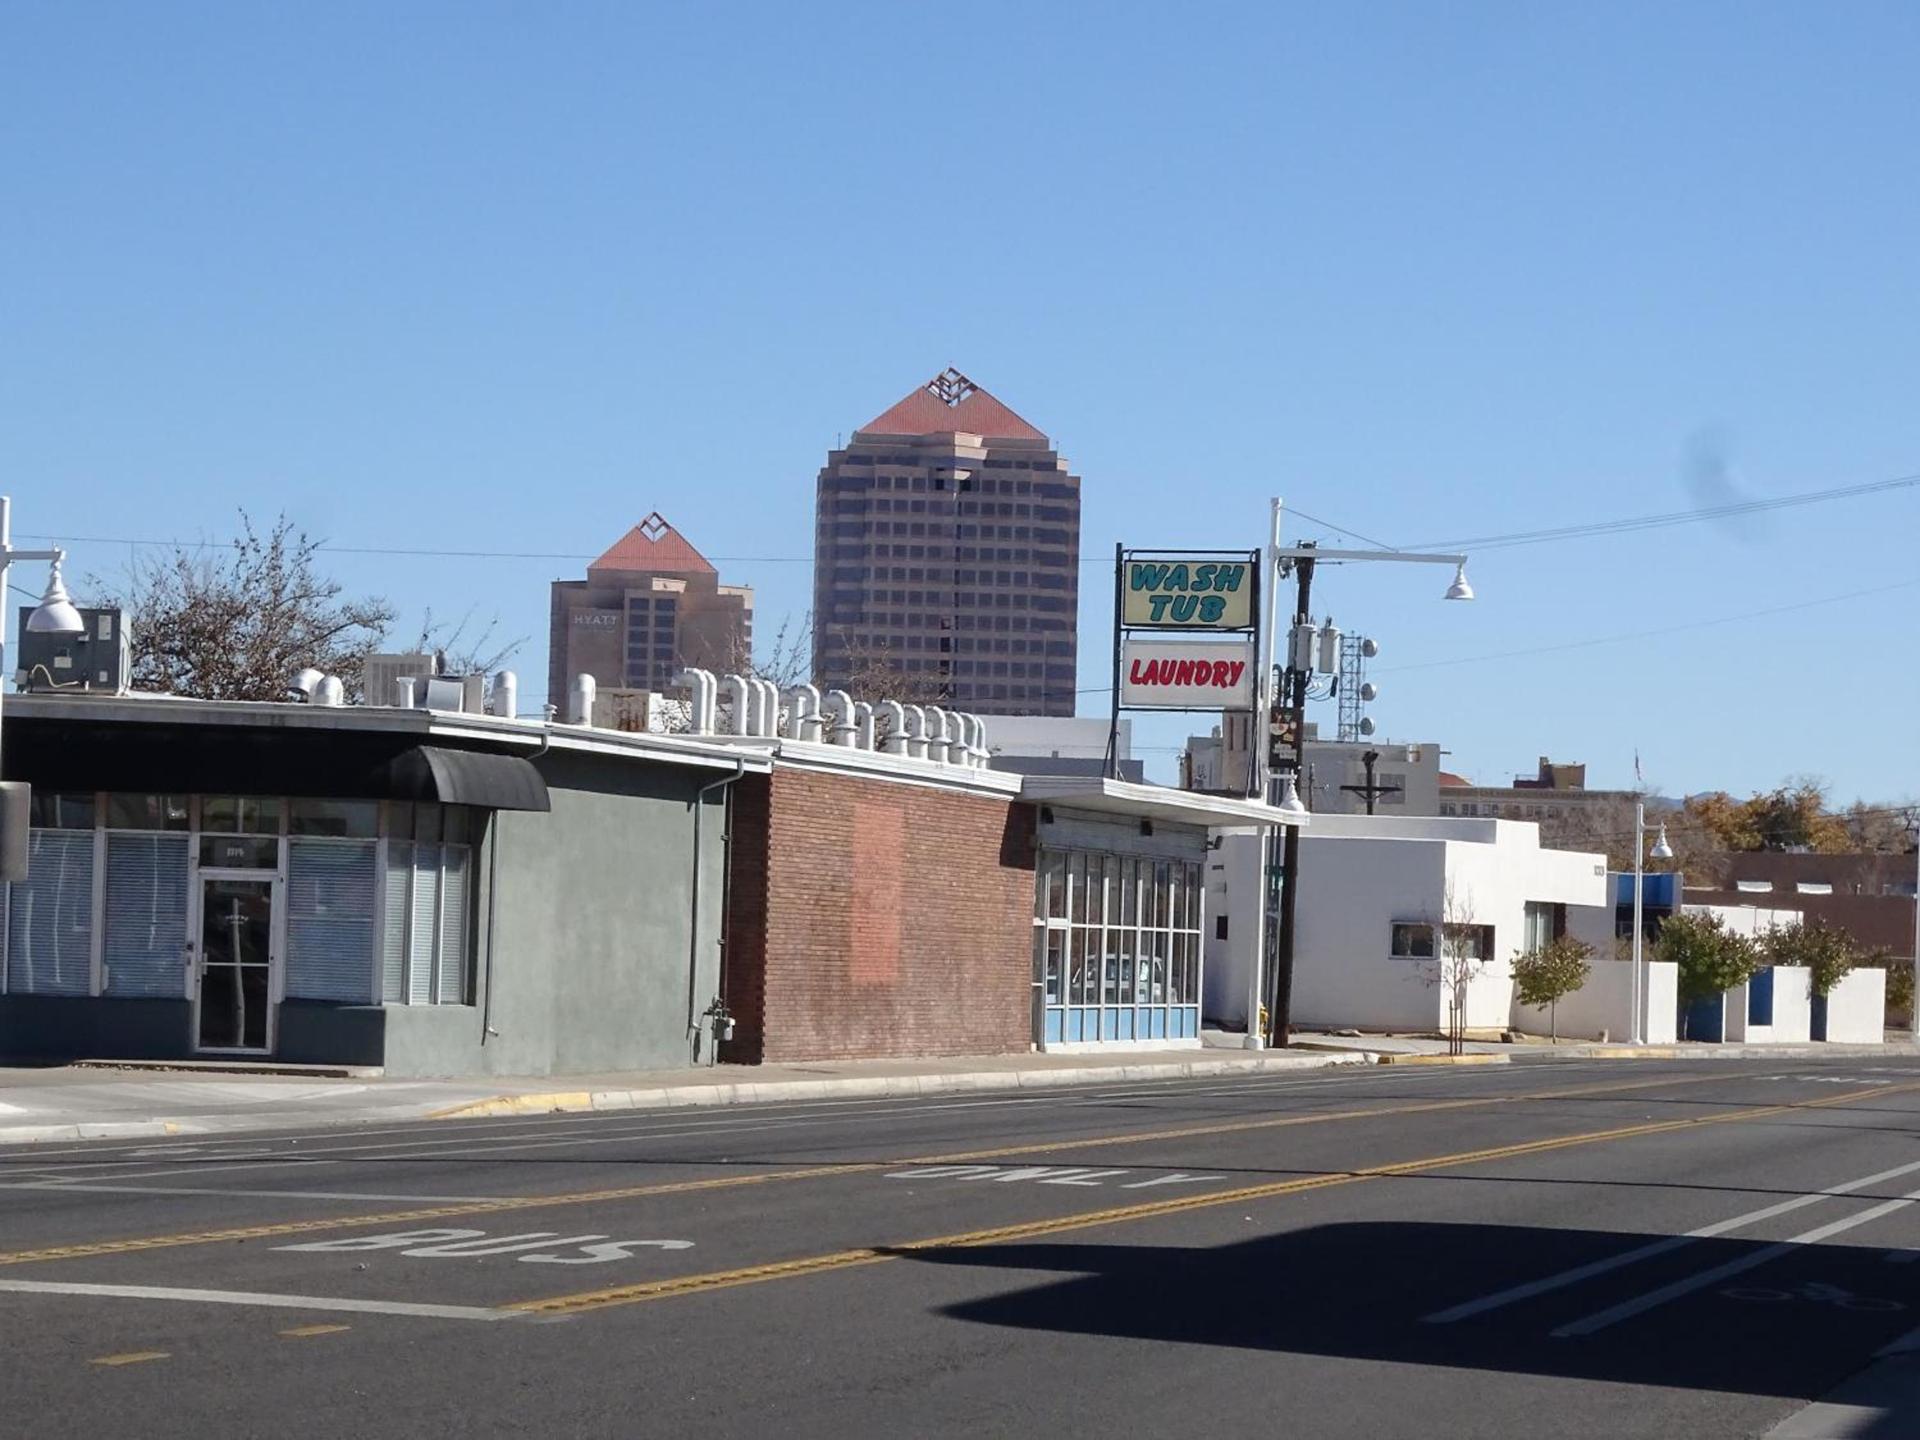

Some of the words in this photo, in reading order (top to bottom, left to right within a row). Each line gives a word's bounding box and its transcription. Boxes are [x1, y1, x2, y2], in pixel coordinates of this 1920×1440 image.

[1131, 564, 1244, 591] WASH
[575, 615, 616, 625] HYATT
[1149, 595, 1226, 622] TUB
[1130, 659, 1245, 688] LAUNDRY
[267, 1229, 695, 1264] BUS
